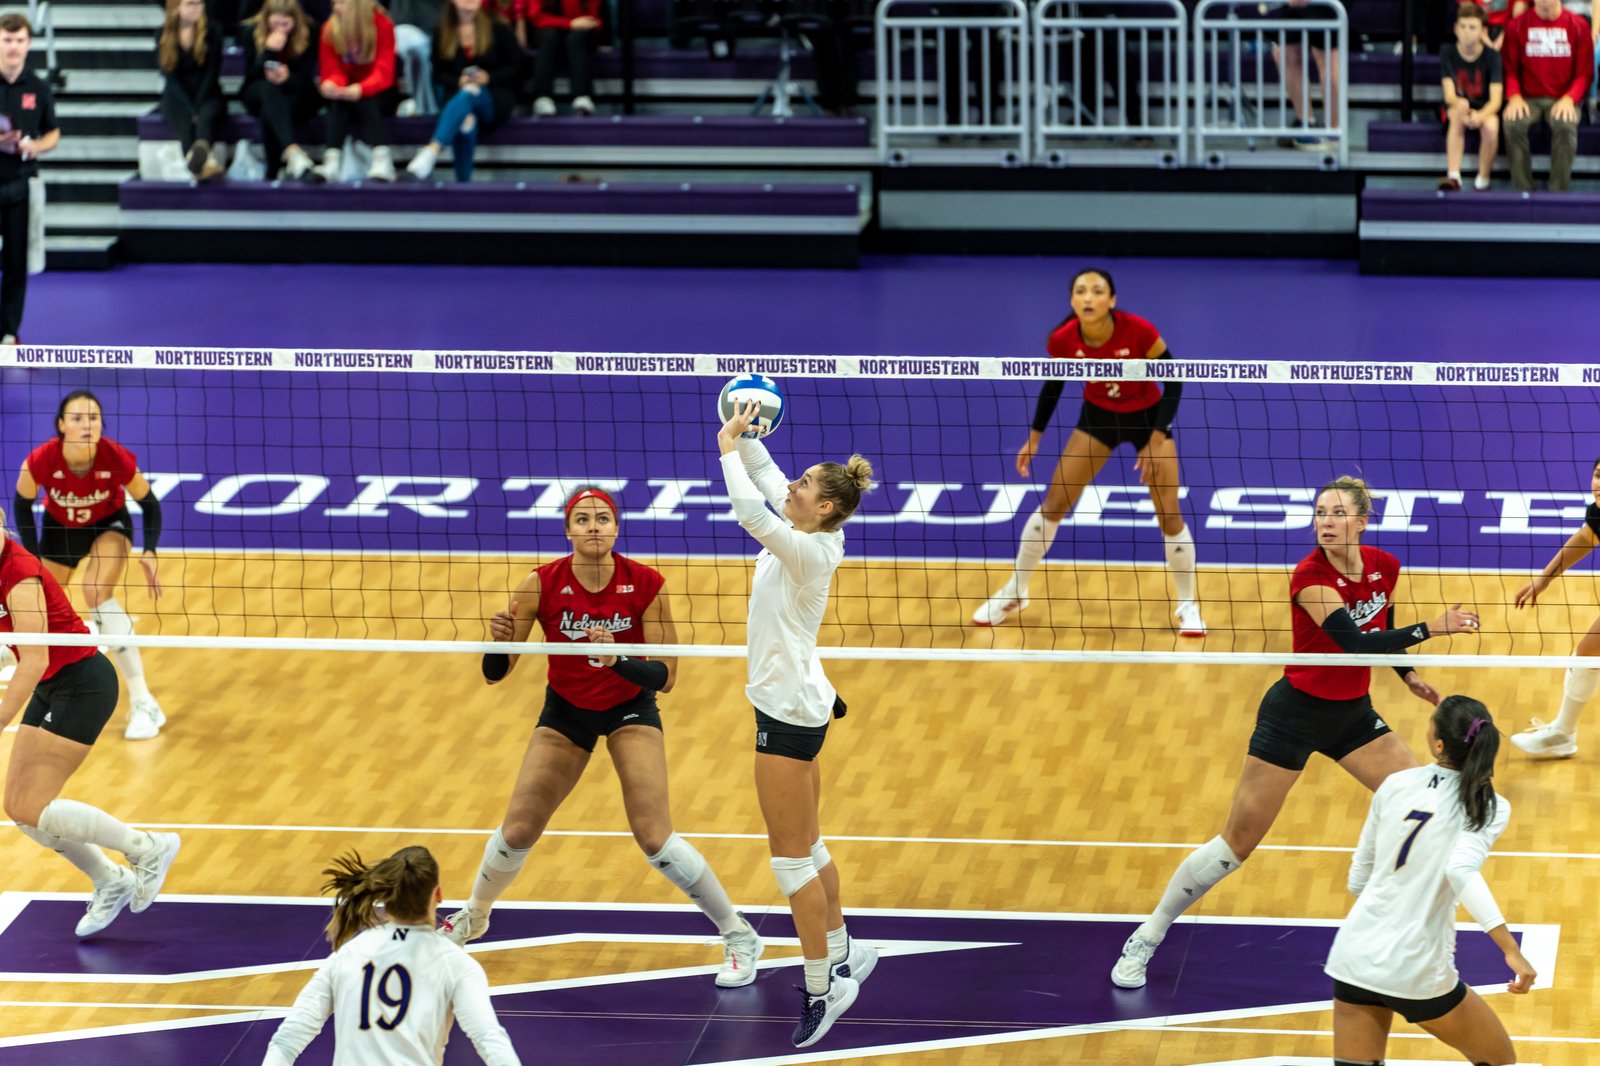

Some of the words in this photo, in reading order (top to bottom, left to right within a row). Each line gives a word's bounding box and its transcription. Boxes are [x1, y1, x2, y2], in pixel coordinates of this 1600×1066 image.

[17, 348, 133, 364] NORTHWESTERN
[155, 350, 273, 366] NORTHWESTERN
[295, 352, 413, 368] NORTHWESTERN
[435, 354, 554, 370] NORTHWESTERN
[575, 356, 695, 371] NORTHWESTERN
[717, 357, 837, 374] NORTHWESTERN
[859, 359, 980, 376] NORTHWESTERN
[1002, 361, 1123, 378] NORTHWESTERN
[1146, 362, 1268, 379] NORTHWESTERN
[1290, 364, 1413, 381] NORTHWESTERN
[1436, 366, 1559, 382] NORTHWESTERN
[1583, 368, 1600, 382] NO
[1105, 382, 1121, 398] 2
[66, 507, 92, 523] 13
[560, 611, 632, 632] Nebraska
[1394, 809, 1434, 872] 7
[392, 928, 410, 941] N
[358, 961, 412, 1031] 19
